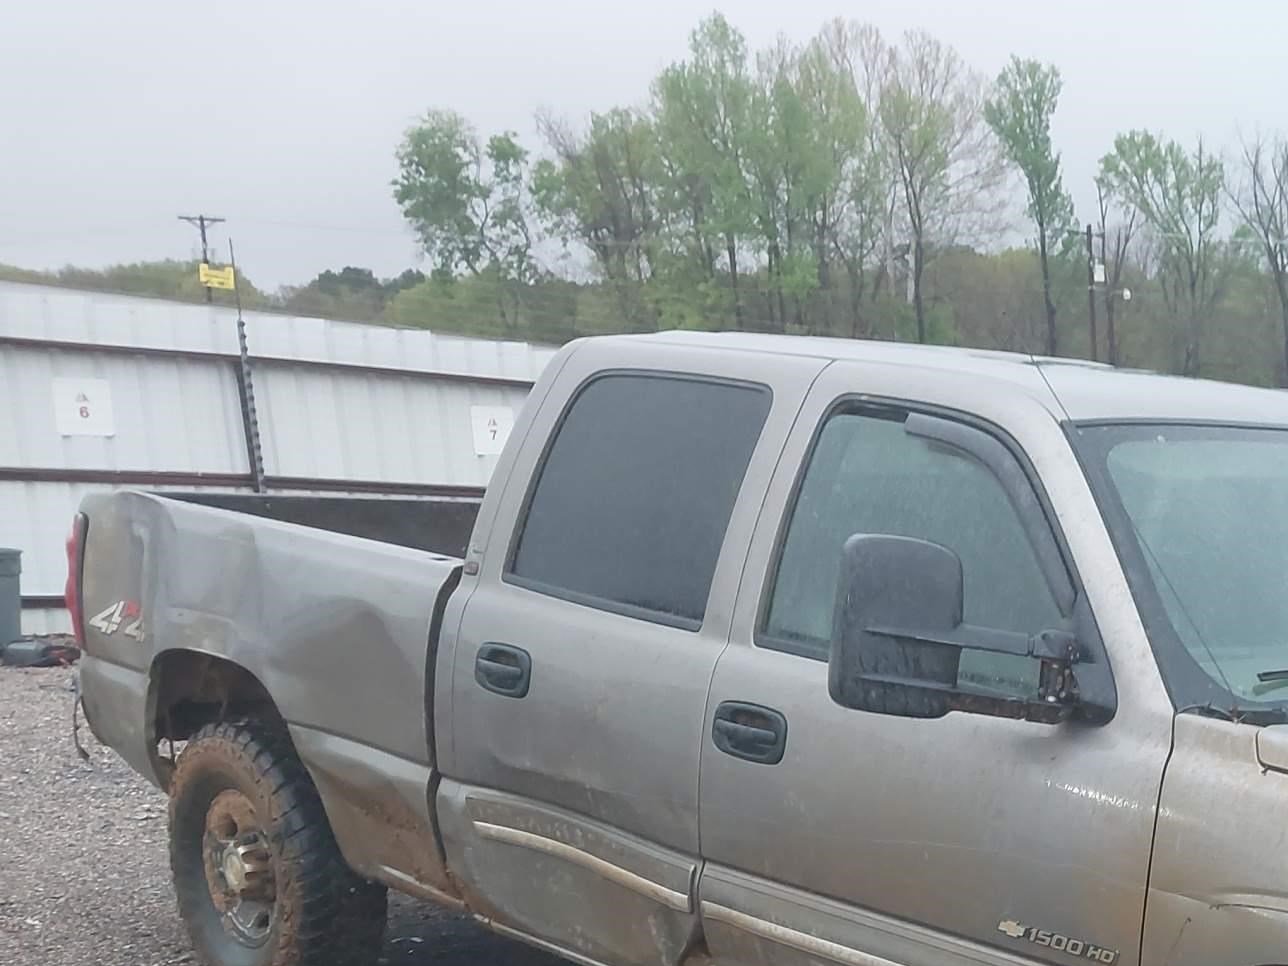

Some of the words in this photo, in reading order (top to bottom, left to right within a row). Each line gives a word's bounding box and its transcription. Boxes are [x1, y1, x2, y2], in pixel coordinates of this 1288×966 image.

[79, 406, 90, 418] 6
[489, 429, 497, 441] 7
[1028, 927, 1084, 956] 1500
[1086, 945, 1116, 964] HD
